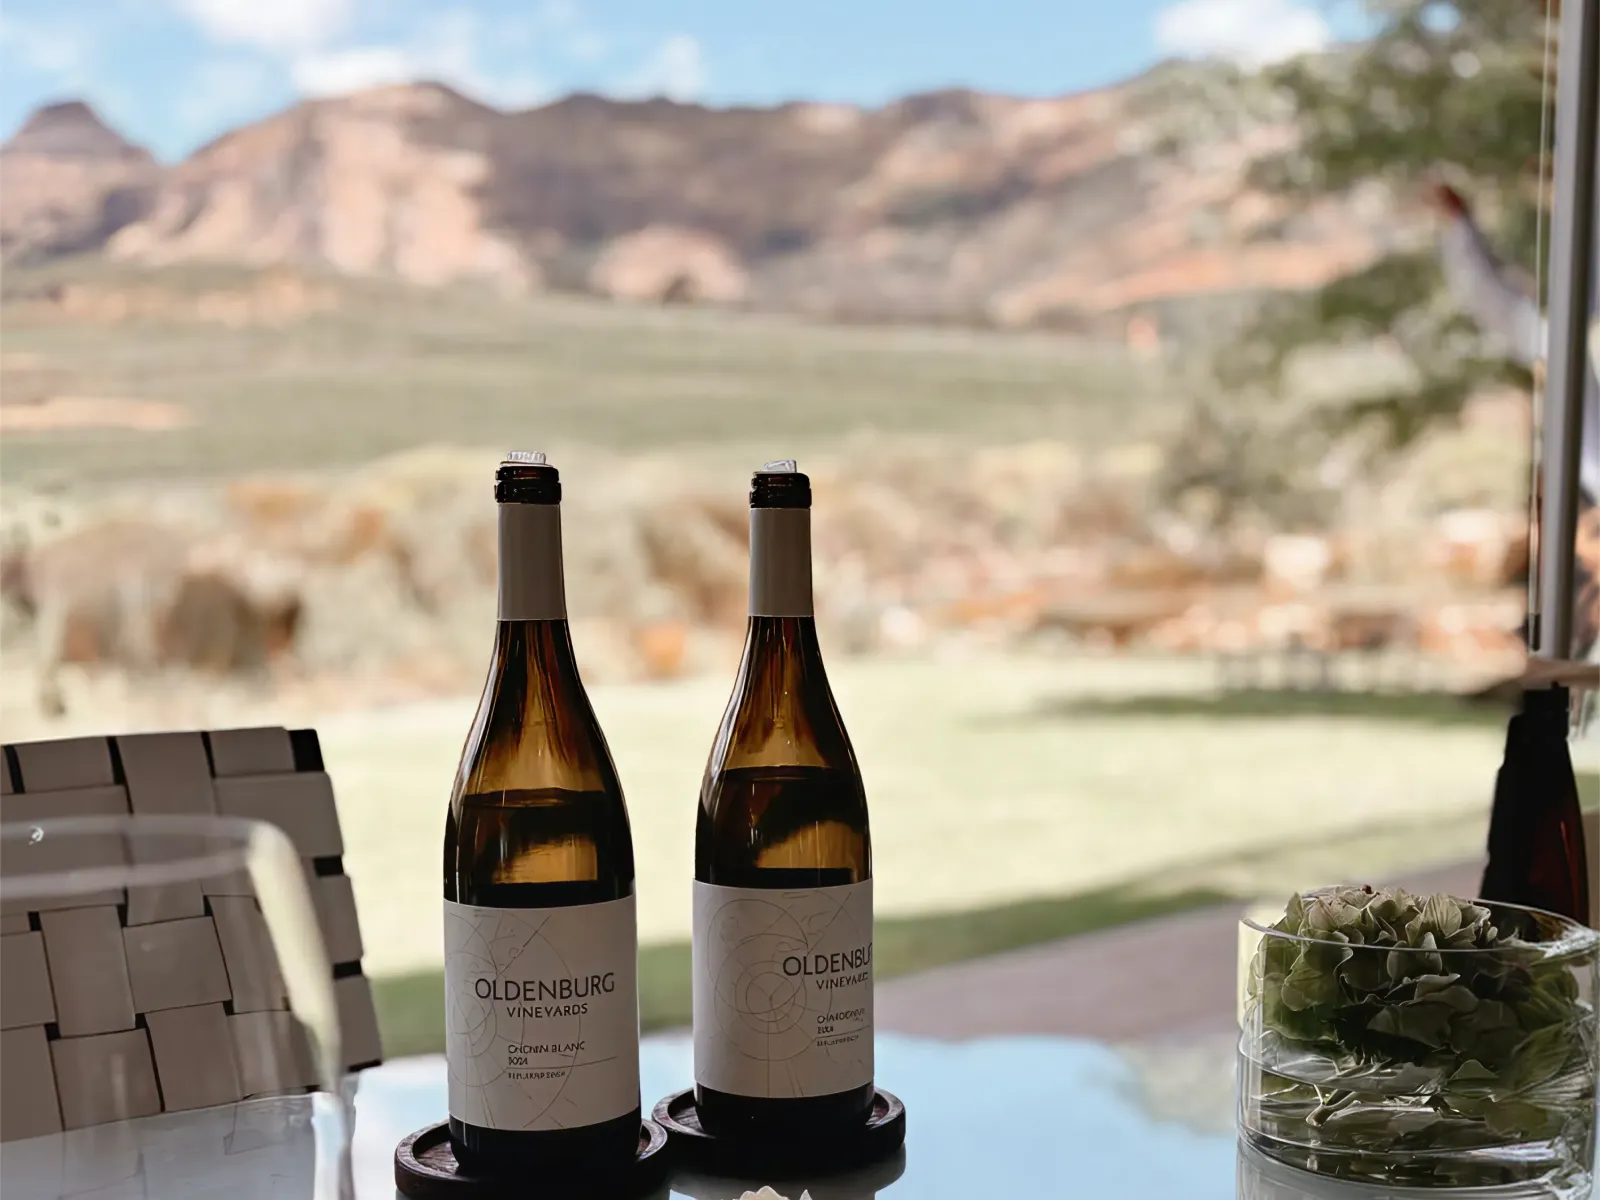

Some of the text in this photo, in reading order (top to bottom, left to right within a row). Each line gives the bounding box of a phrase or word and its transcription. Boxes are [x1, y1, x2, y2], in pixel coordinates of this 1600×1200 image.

[474, 972, 615, 1001] OLDENBURG
[506, 1003, 588, 1018] VINEYARDS
[551, 1040, 586, 1053] BLANC
